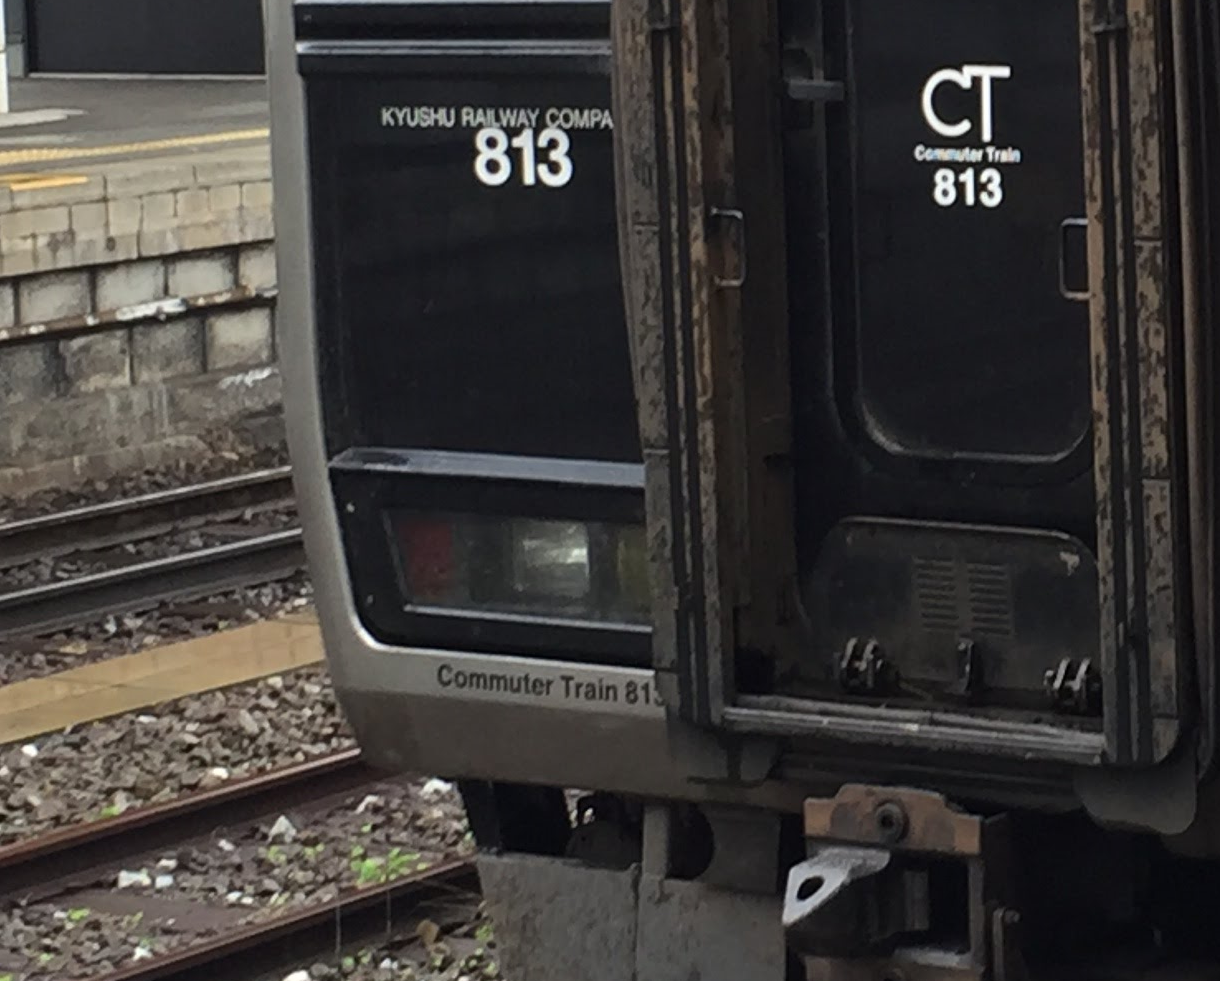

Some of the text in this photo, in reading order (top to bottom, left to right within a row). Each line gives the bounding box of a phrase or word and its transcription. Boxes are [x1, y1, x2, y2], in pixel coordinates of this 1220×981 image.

[381, 106, 456, 128] KYUSHU
[461, 107, 540, 129] RAILWAY
[922, 64, 1011, 143] CT
[474, 127, 573, 188] 813
[914, 144, 1021, 163] Commuter Train
[933, 167, 1003, 208] 813
[436, 663, 554, 697] Commuter
[560, 674, 618, 703] Train
